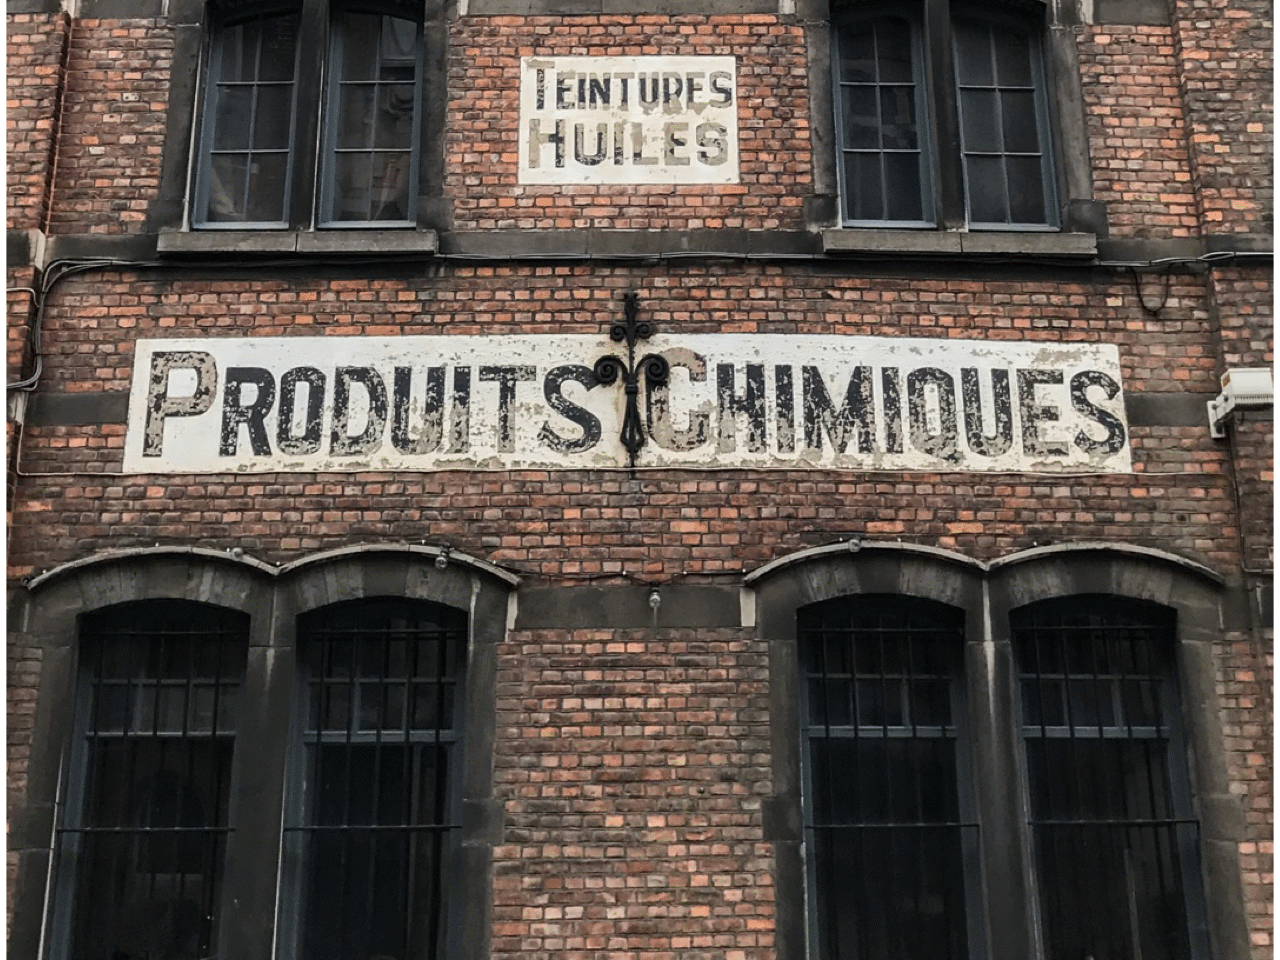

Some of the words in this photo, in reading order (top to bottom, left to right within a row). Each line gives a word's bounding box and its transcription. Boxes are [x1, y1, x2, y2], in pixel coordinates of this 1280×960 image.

[525, 61, 733, 115] TEINTURES
[528, 119, 728, 168] HUILES
[143, 351, 602, 458] PRODUITS
[646, 347, 1126, 460] CHIMIQUES
